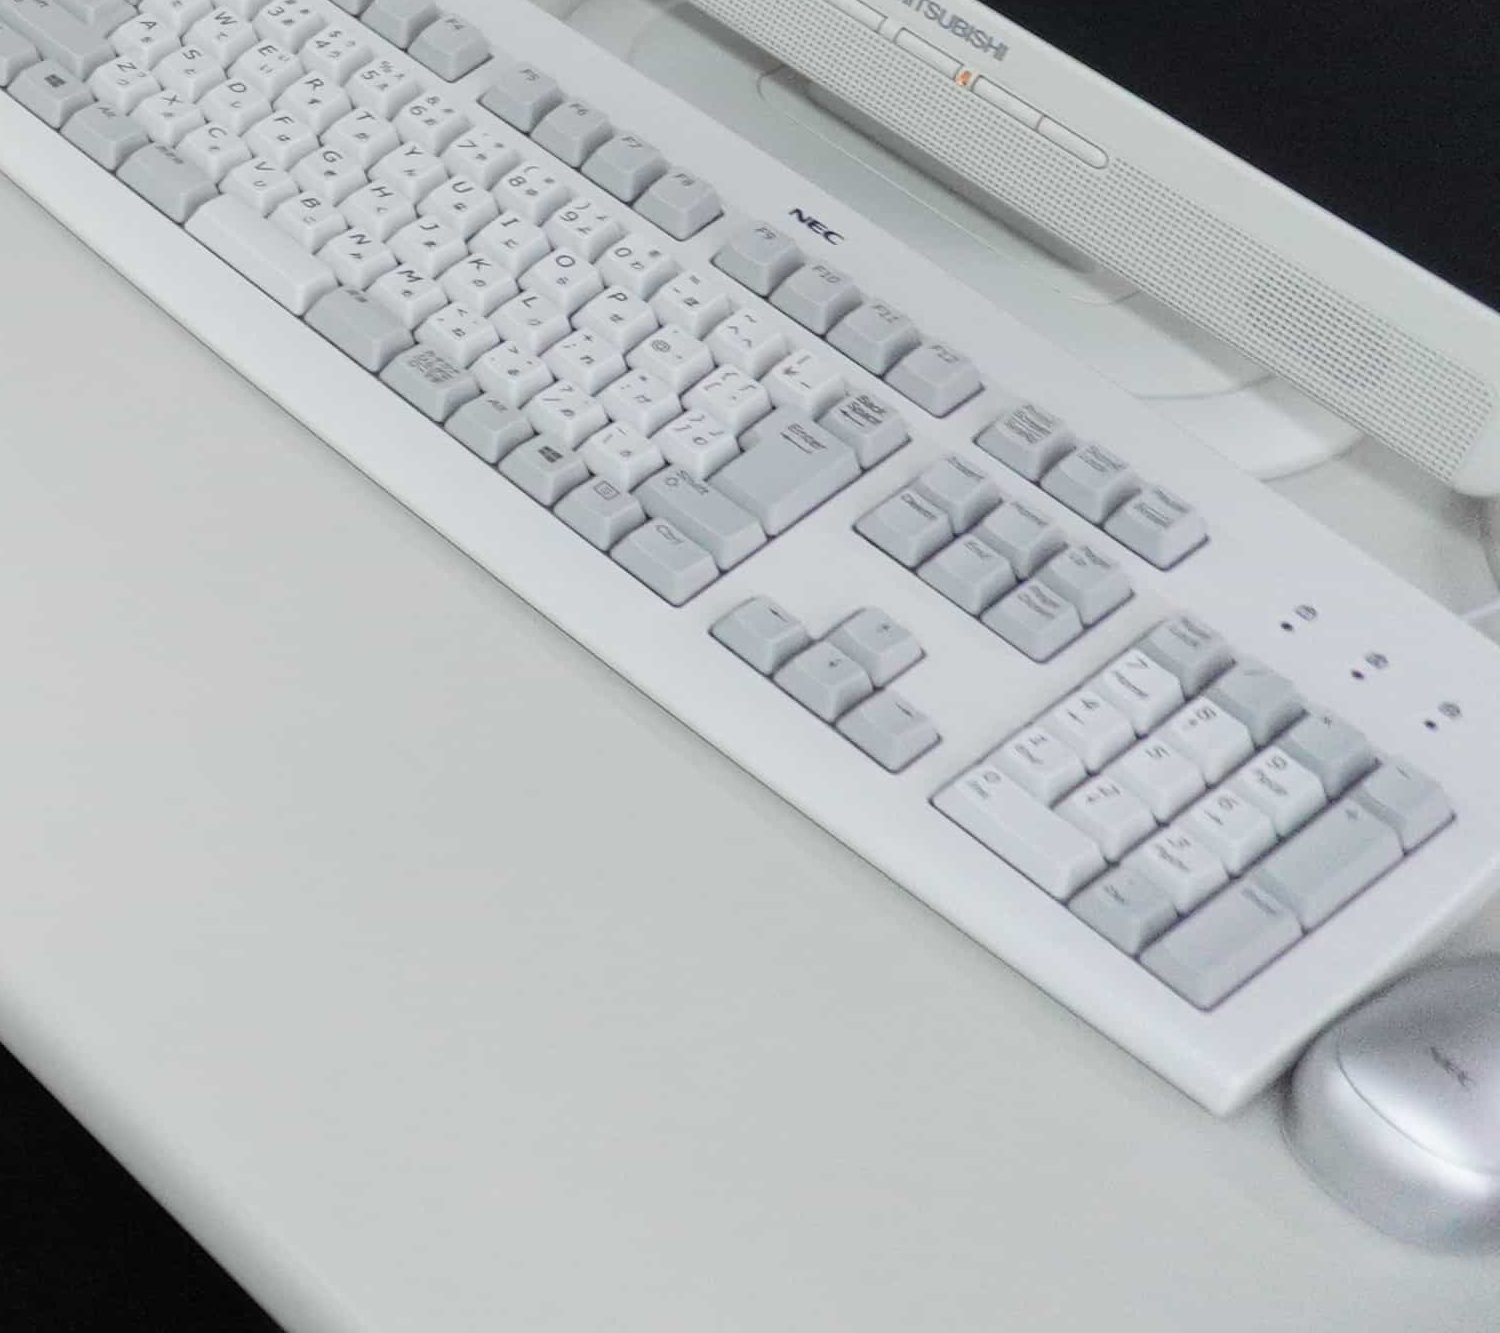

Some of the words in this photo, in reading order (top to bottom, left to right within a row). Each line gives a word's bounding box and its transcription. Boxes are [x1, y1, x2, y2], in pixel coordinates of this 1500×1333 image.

[267, 5, 285, 17] 3
[139, 19, 158, 30] A
[214, 11, 238, 27] W
[315, 38, 331, 49] 4
[182, 48, 202, 61] S
[257, 44, 279, 57] E
[116, 60, 139, 73] Z
[360, 69, 381, 81] 5
[228, 82, 248, 94] D
[304, 77, 326, 92] R
[162, 93, 184, 105] X
[354, 110, 377, 122] T
[409, 105, 428, 117] 6
[273, 115, 296, 126] F
[207, 126, 228, 139] C
[403, 144, 424, 158] Y
[457, 139, 479, 150] 7
[322, 149, 344, 164] G
[253, 160, 277, 173] V
[451, 180, 475, 194] U
[508, 175, 528, 188] 8
[370, 185, 395, 199] H
[301, 197, 323, 209] B
[499, 216, 521, 228] I
[559, 210, 580, 222] 9
[419, 222, 440, 232] J
[787, 208, 845, 246] NEC
[349, 232, 373, 246] N
[468, 257, 492, 270] K
[555, 254, 576, 268] O
[397, 269, 425, 284] M
[811, 264, 843, 284] F10
[521, 295, 541, 309] L
[606, 291, 629, 303] P
